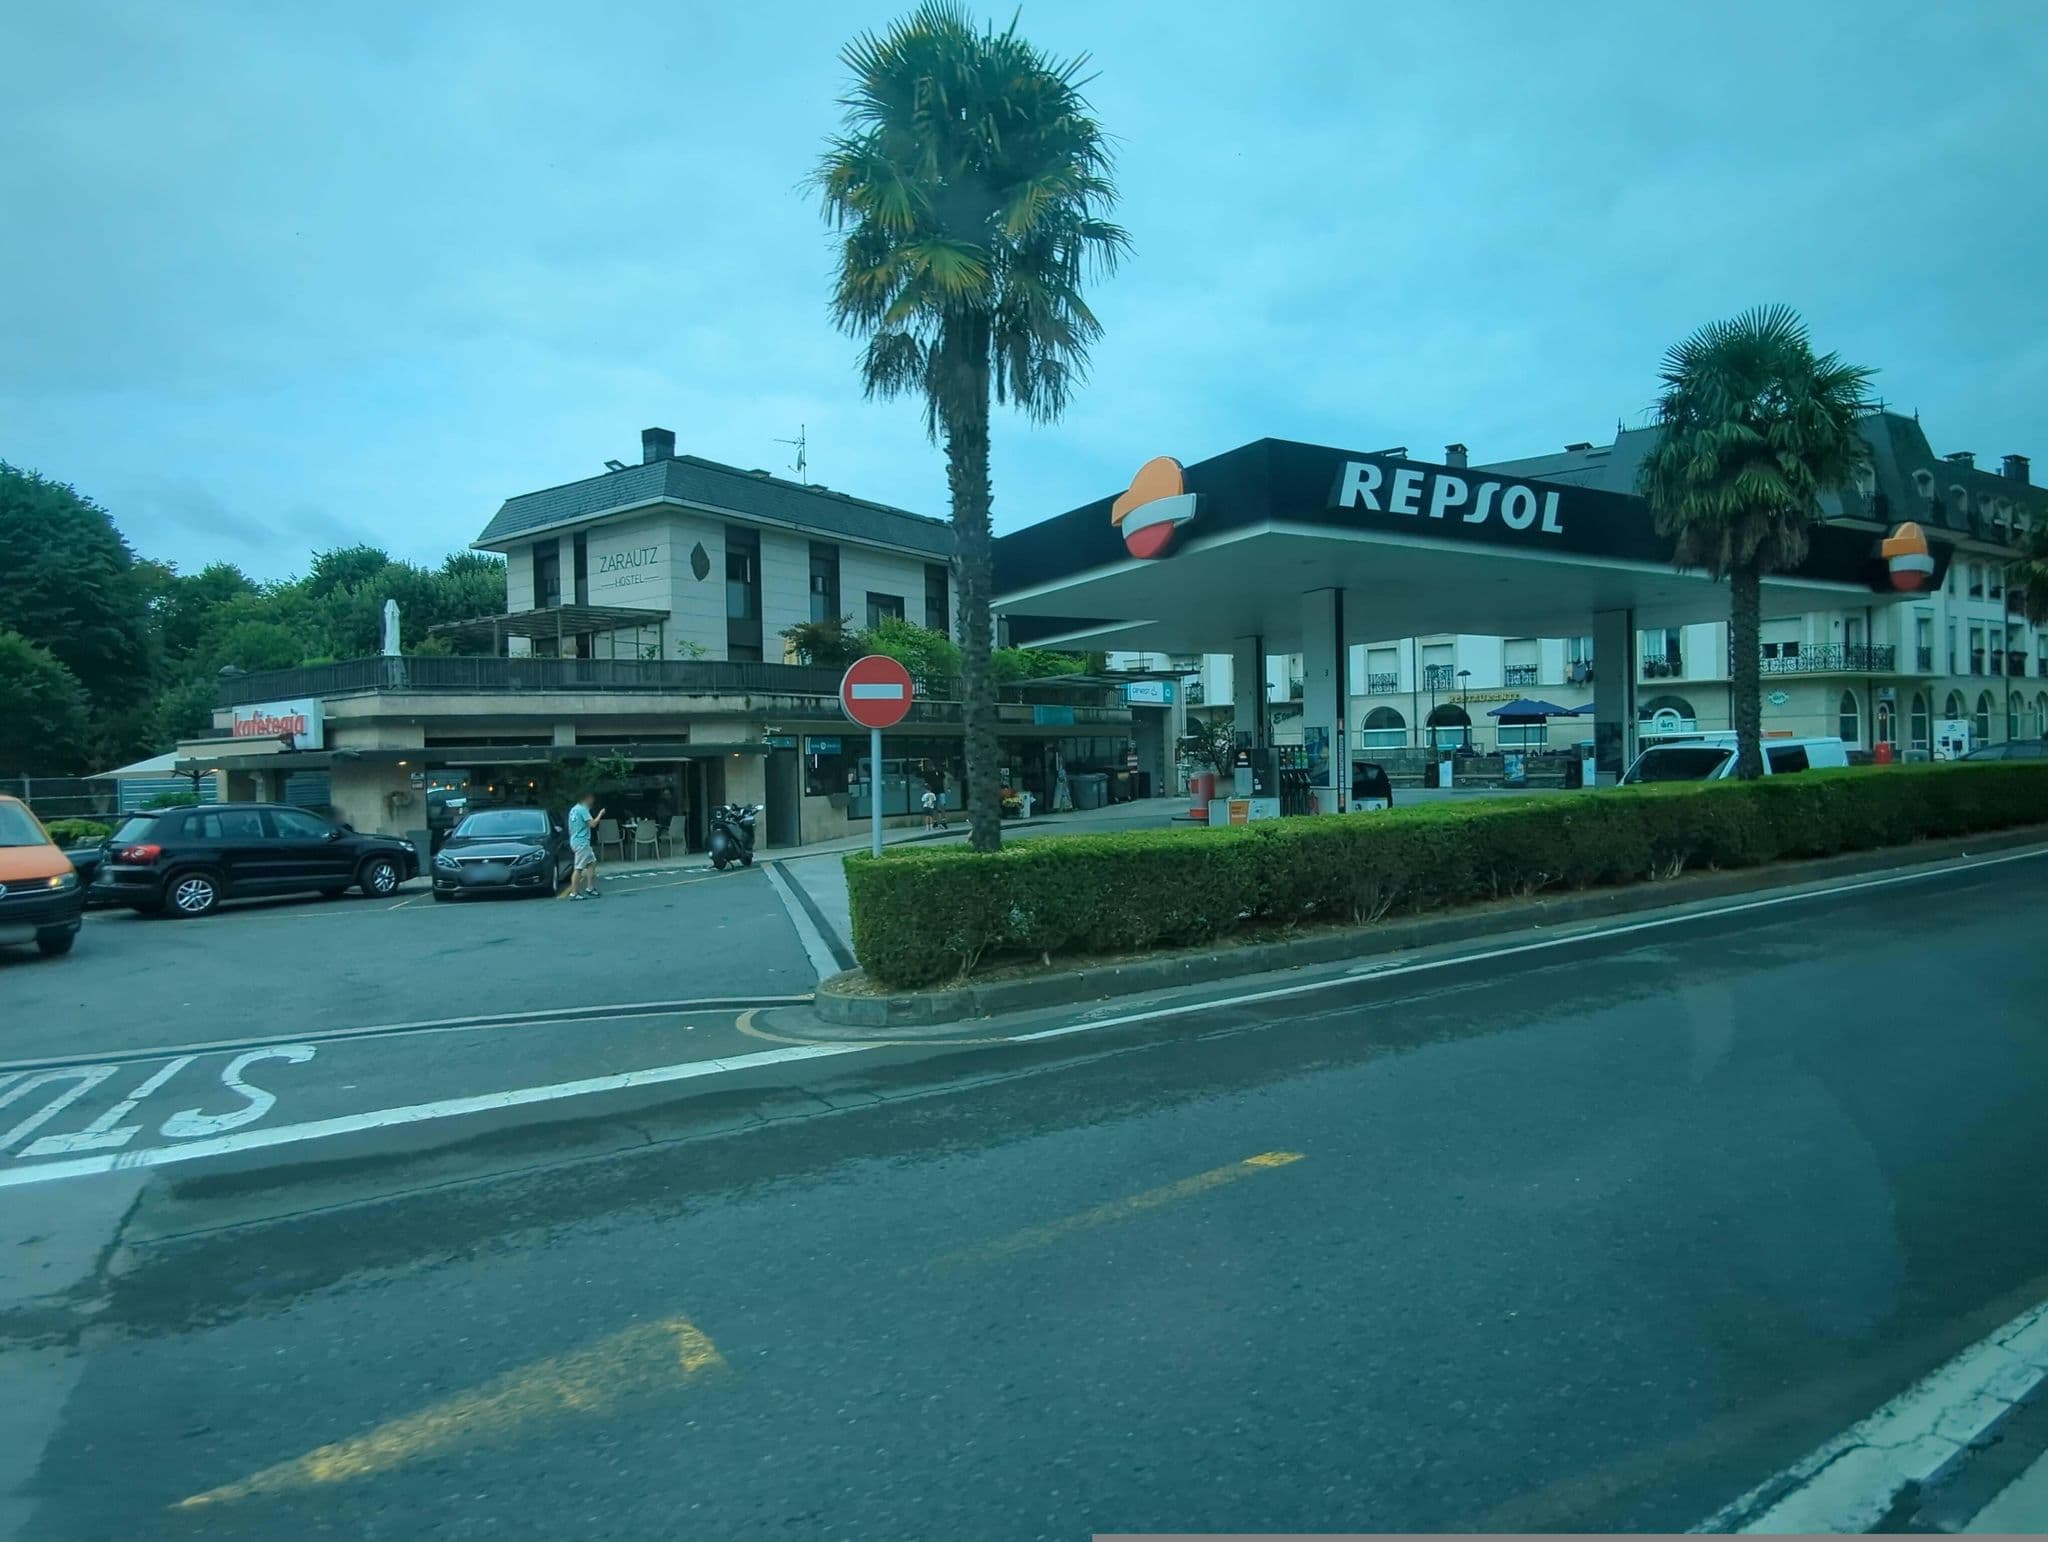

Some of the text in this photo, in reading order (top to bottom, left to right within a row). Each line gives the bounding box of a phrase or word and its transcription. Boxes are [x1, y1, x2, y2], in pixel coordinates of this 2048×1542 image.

[1339, 461, 1562, 534] REPSOL
[600, 547, 658, 573] ZARAUTZ
[615, 574, 644, 587] HOSTEL
[0, 1045, 317, 1158] STO
